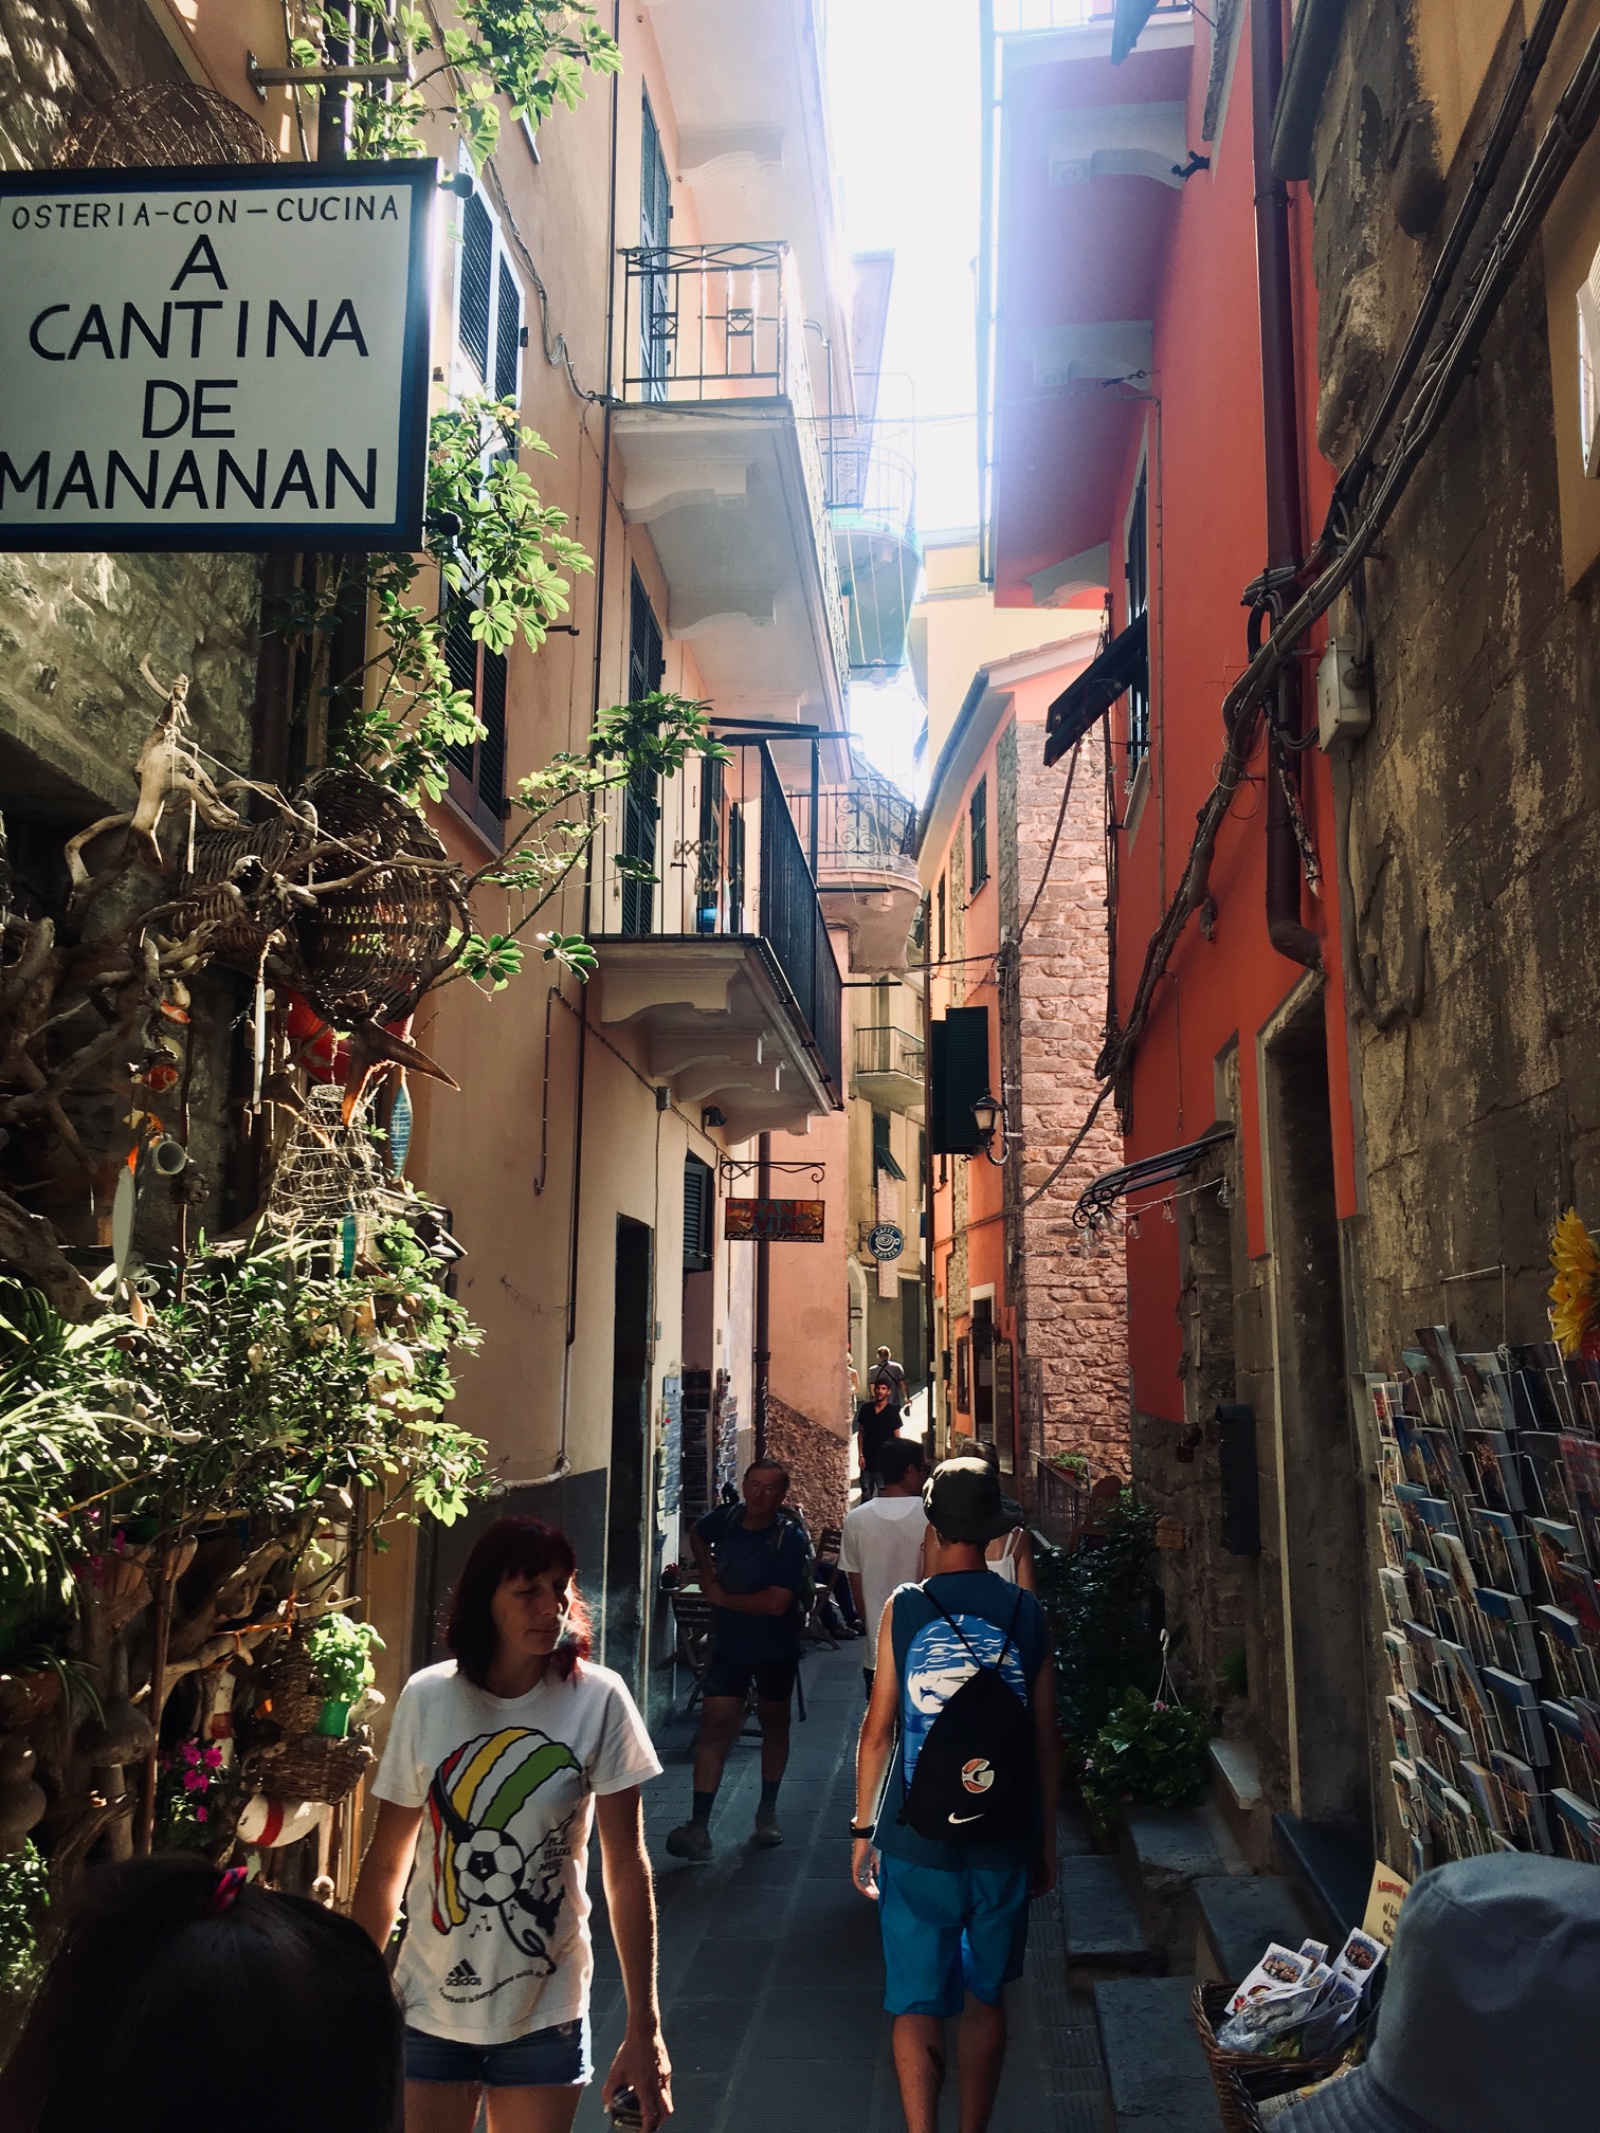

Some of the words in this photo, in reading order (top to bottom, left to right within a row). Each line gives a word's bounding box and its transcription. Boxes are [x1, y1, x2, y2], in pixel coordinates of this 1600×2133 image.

[170, 234, 228, 291] A
[29, 299, 369, 361] CANTINA
[142, 379, 238, 439] DE
[0, 448, 377, 510] MANANAN
[445, 1976, 482, 1986] adidas
